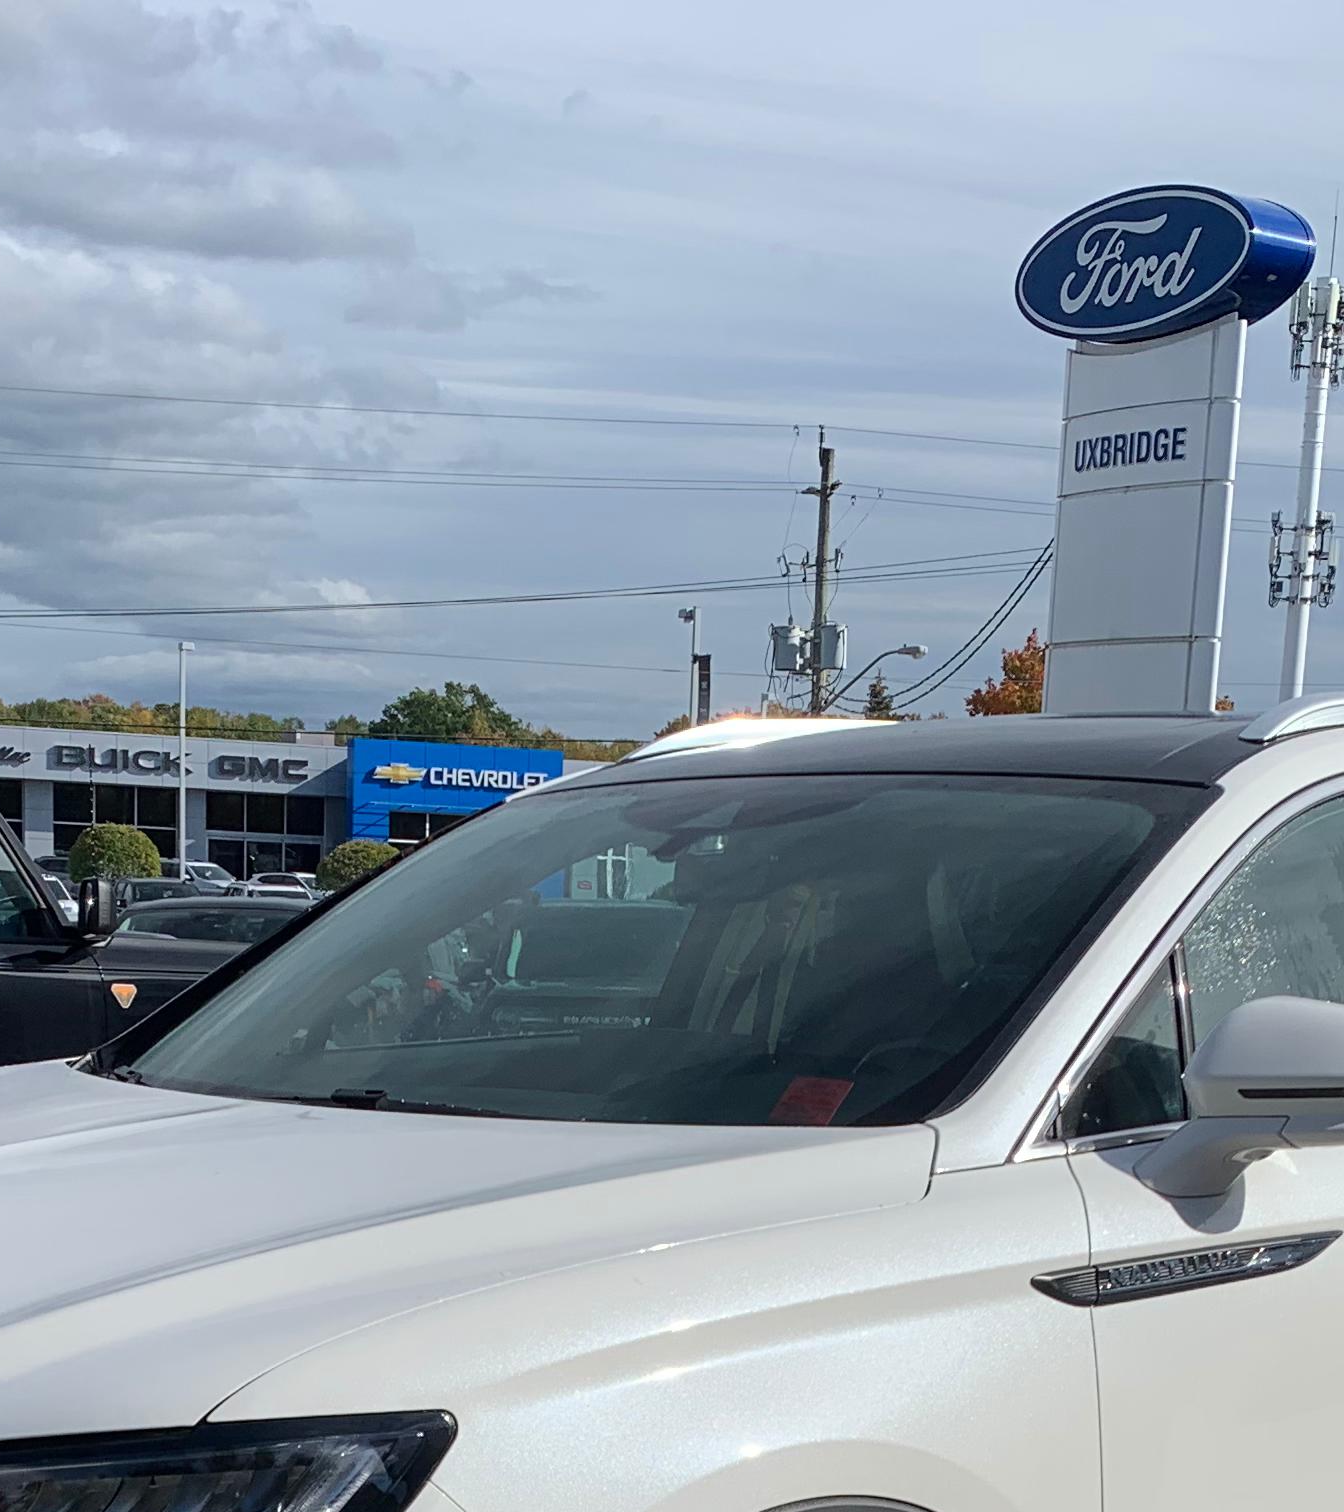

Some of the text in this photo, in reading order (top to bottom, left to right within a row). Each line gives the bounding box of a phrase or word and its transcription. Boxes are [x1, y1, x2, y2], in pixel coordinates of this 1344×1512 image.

[1060, 213, 1202, 315] Ford
[1074, 427, 1187, 473] UXBRIDGE
[55, 744, 194, 776] BUICK
[216, 755, 309, 783] GMC
[429, 767, 549, 790] CHEVROLET
